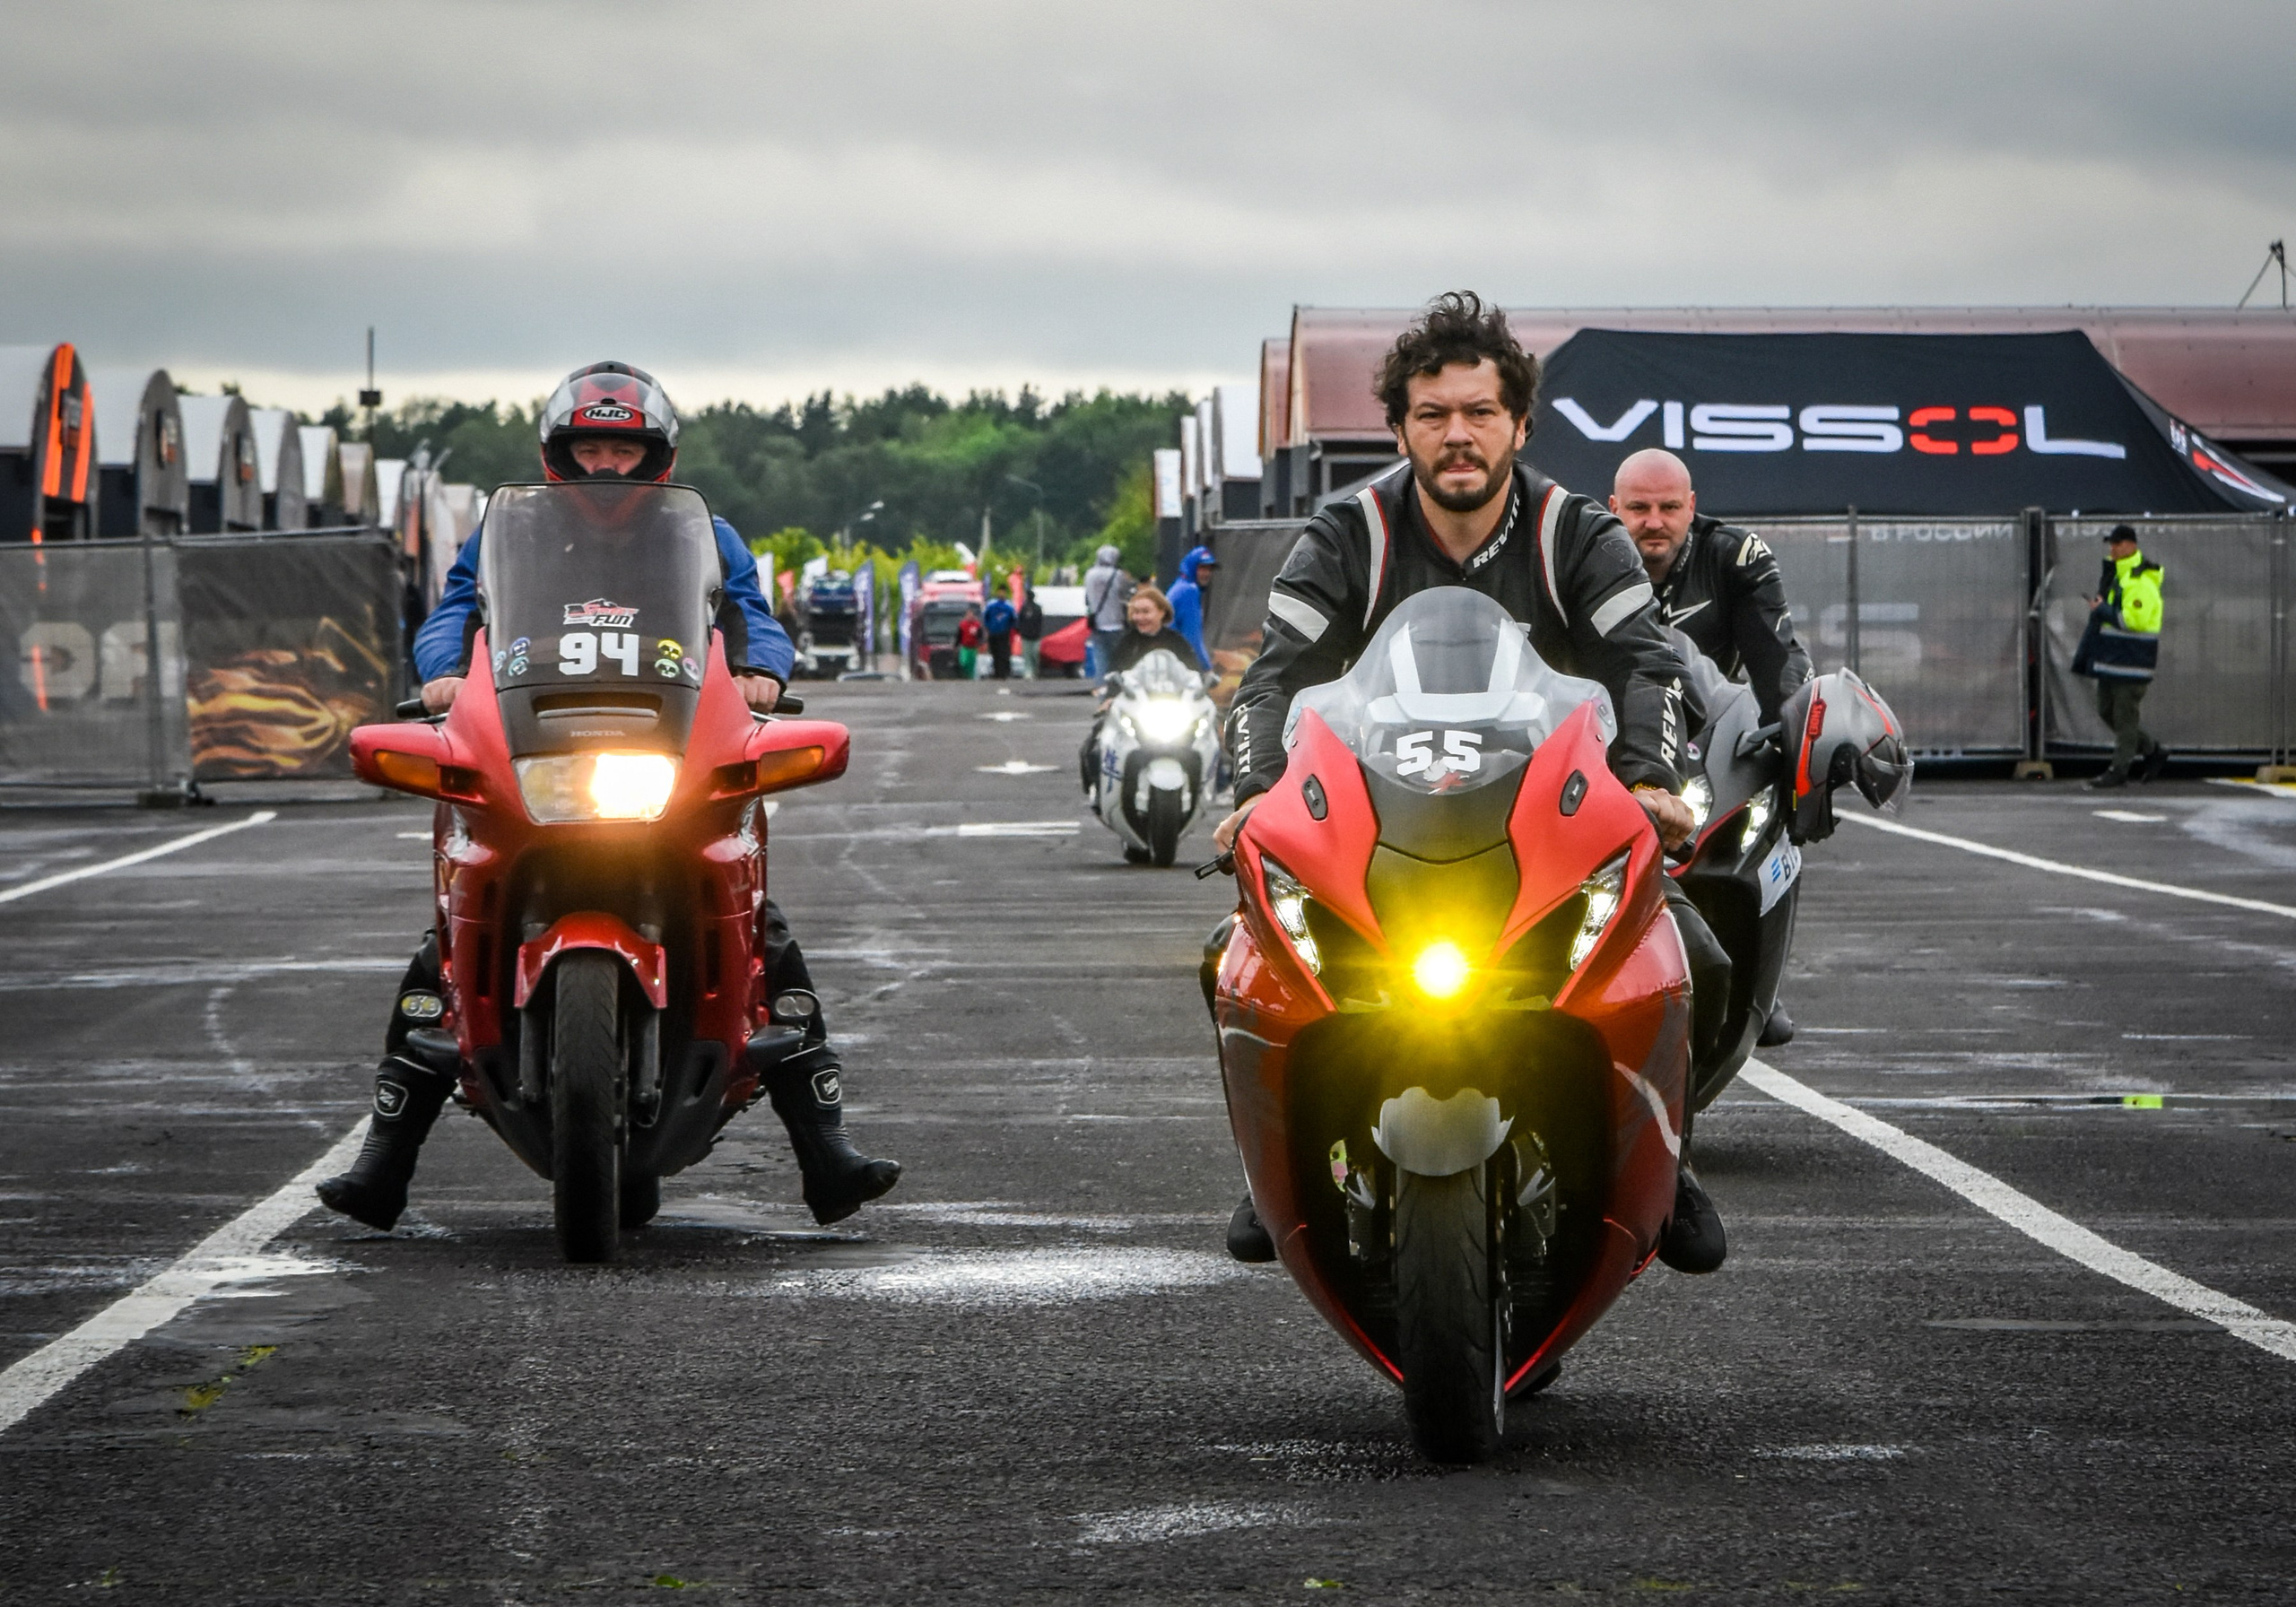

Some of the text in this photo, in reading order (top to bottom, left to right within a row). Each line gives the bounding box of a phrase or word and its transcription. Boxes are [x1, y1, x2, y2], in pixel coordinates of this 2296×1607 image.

[589, 409, 628, 419] HJC
[1552, 397, 2126, 458] VISSOL
[1896, 523, 2013, 542] РОССИИ
[559, 632, 639, 676] 94
[1396, 730, 1483, 777] 55
